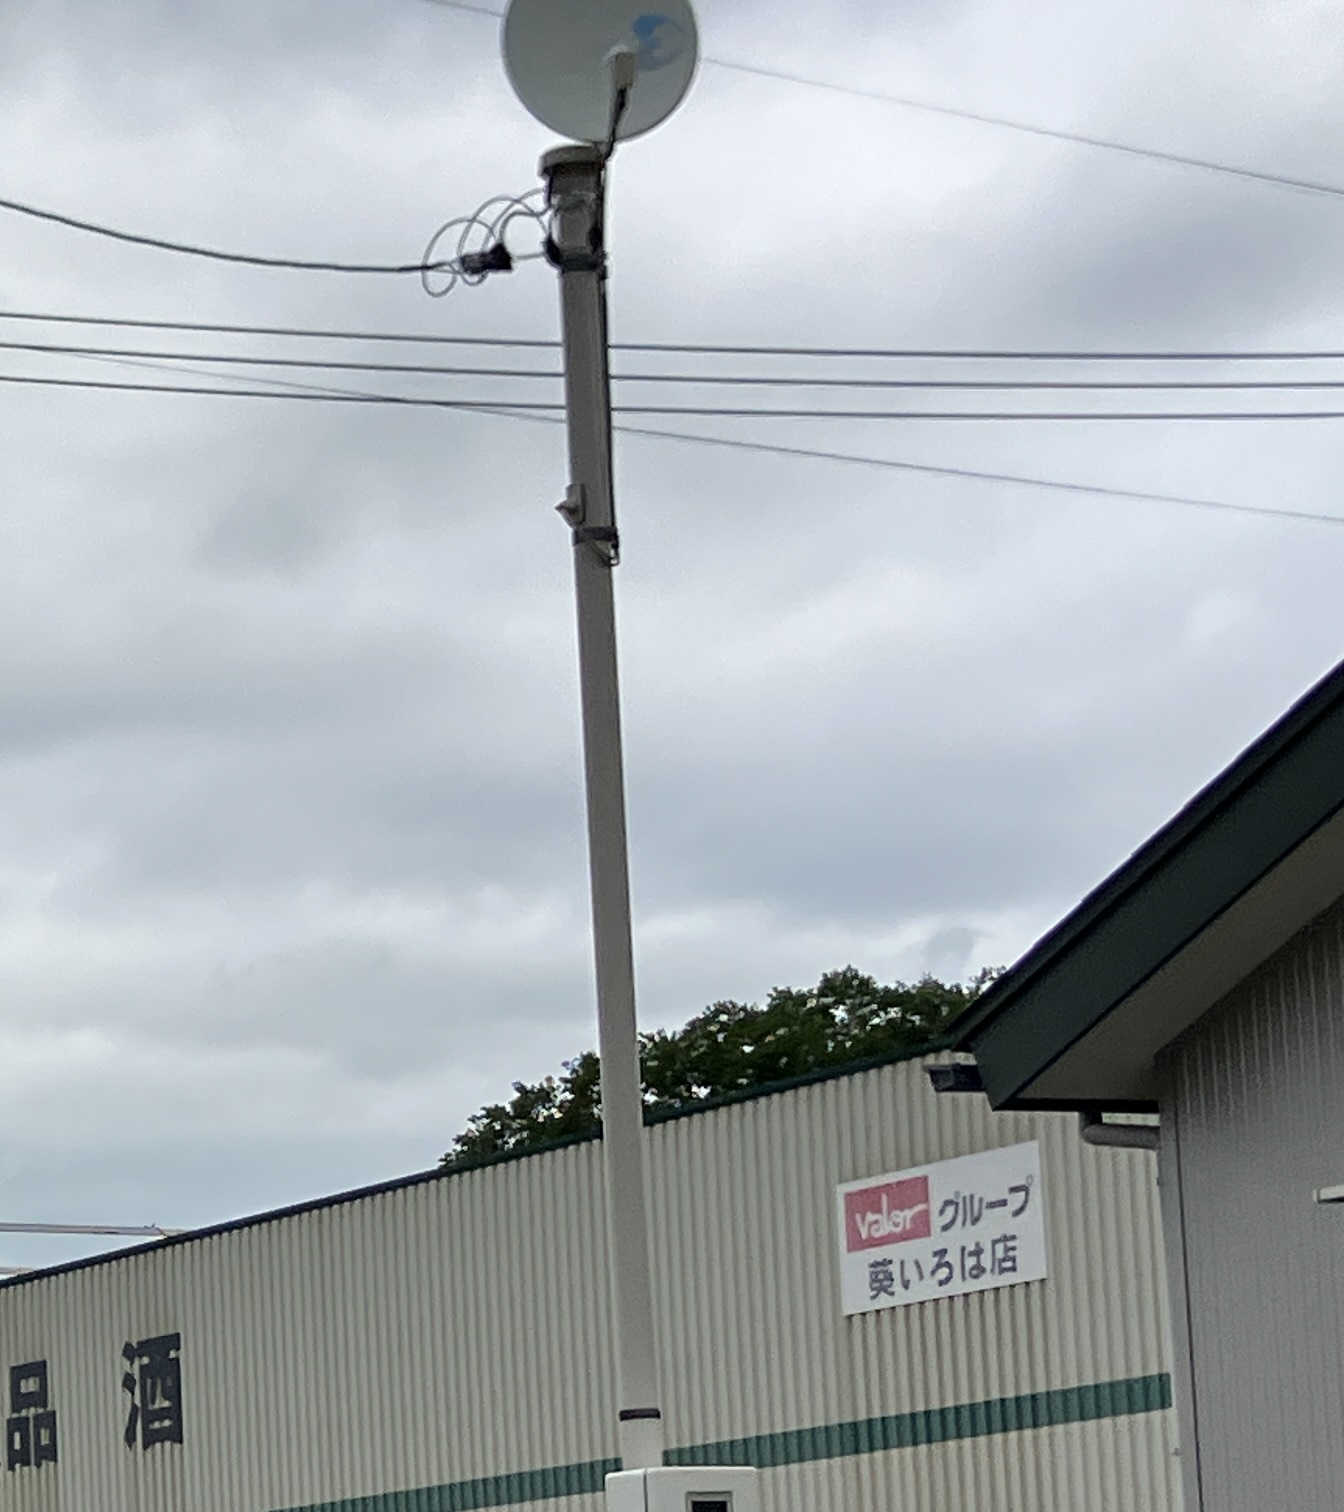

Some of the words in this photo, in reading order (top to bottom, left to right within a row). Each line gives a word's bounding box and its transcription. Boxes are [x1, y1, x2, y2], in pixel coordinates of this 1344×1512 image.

[939, 1175, 1034, 1233] グループ
[868, 1233, 1018, 1300] 葵いろは店
[122, 1332, 183, 1450] 酒
